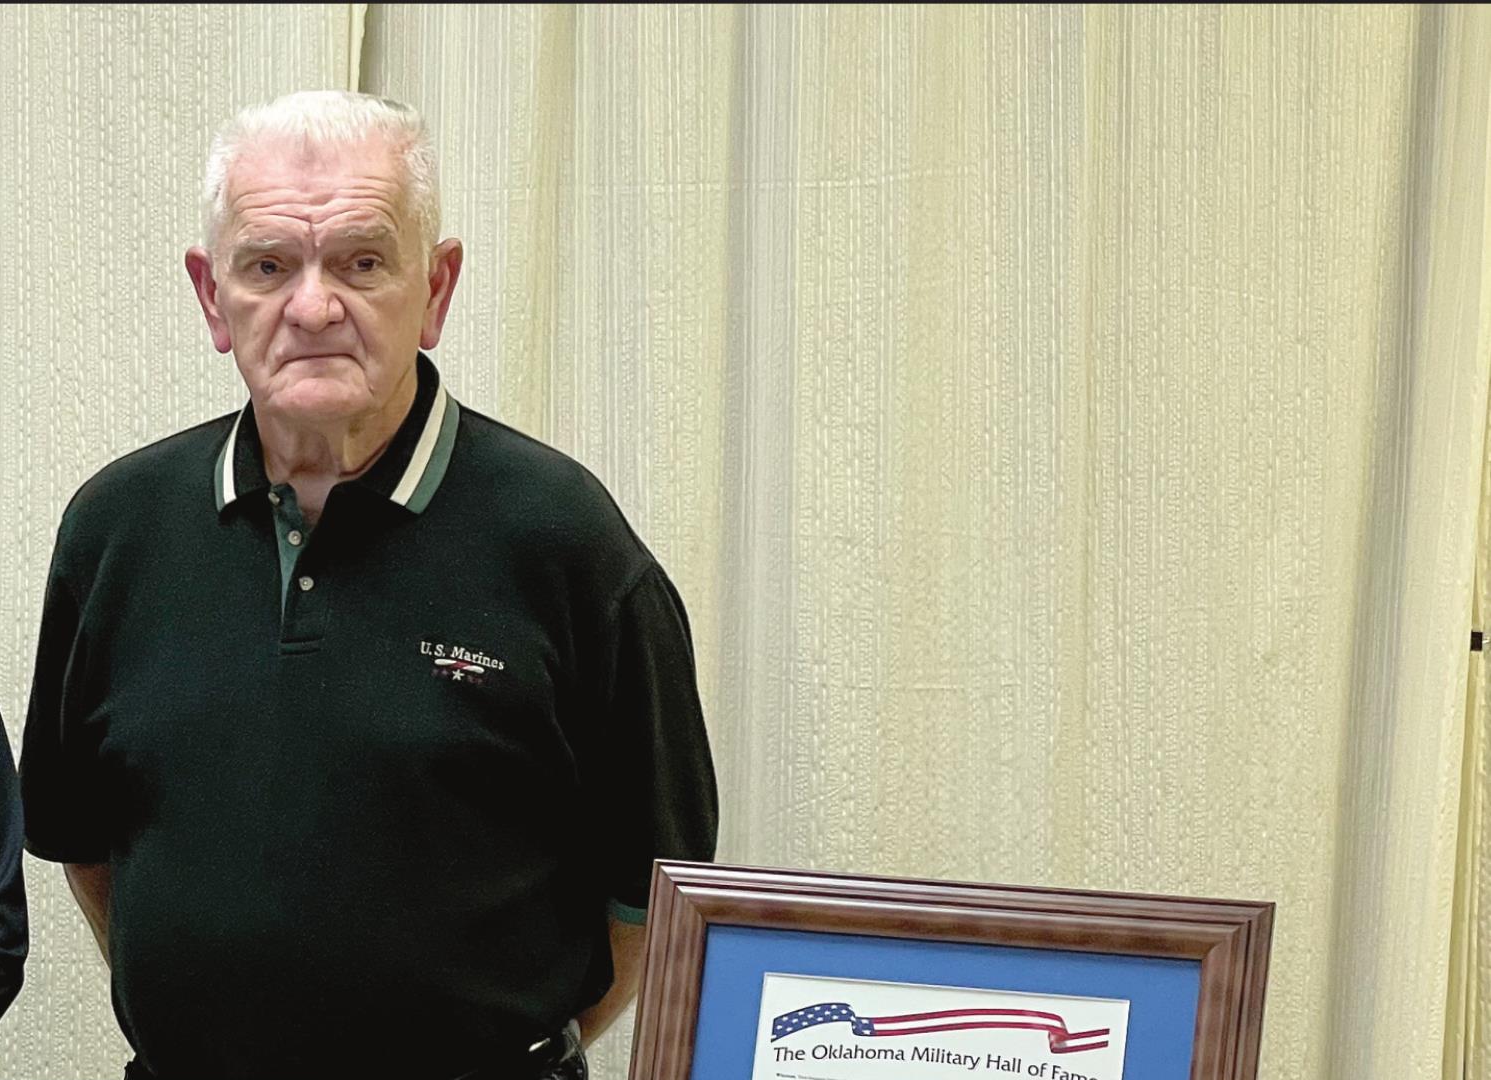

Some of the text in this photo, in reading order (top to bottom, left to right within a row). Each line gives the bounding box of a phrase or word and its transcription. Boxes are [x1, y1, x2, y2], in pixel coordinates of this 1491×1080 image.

[420, 641, 505, 670] U.S. Marines
[774, 1046, 806, 1063] The
[811, 1044, 905, 1062] Oklahoma
[910, 1046, 980, 1070] Military
[986, 1054, 1021, 1074] Hall
[1028, 1062, 1048, 1077] of
